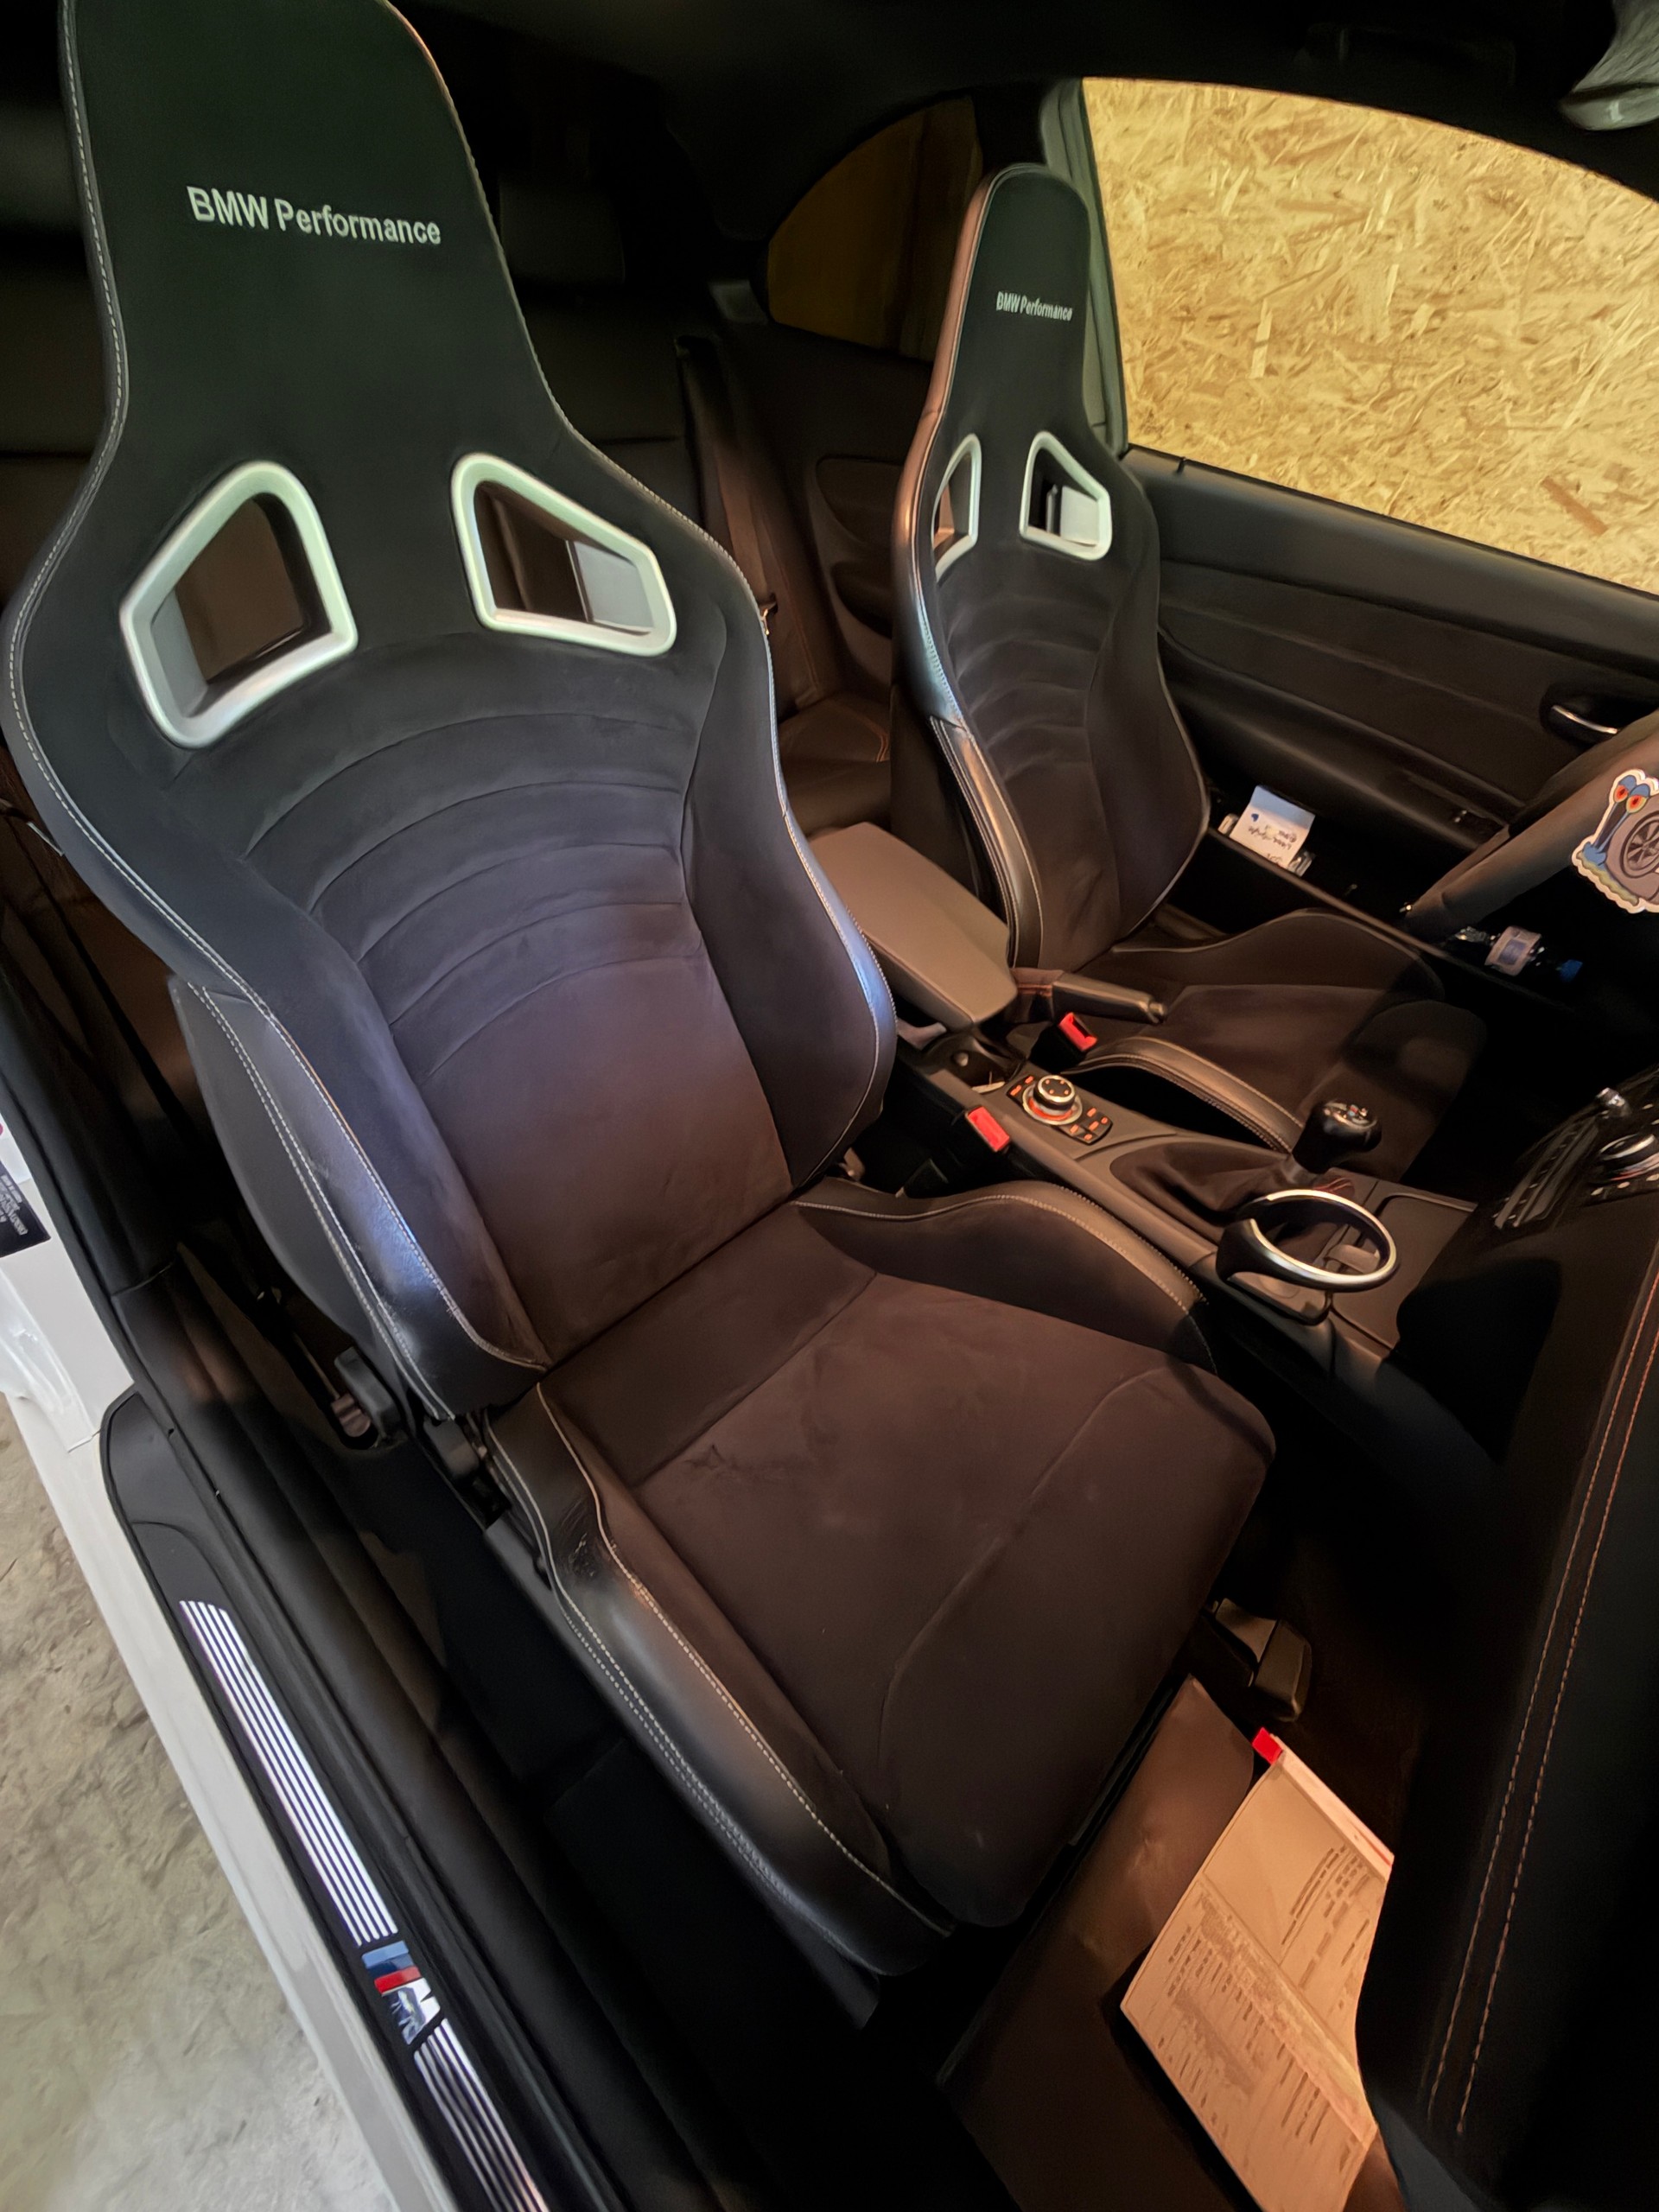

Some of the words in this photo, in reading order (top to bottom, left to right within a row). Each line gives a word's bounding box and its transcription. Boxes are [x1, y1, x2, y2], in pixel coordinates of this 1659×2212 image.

[186, 185, 270, 231] BMW
[274, 197, 442, 245] Performance
[995, 290, 1020, 313] BMW
[1020, 295, 1073, 321] Performance
